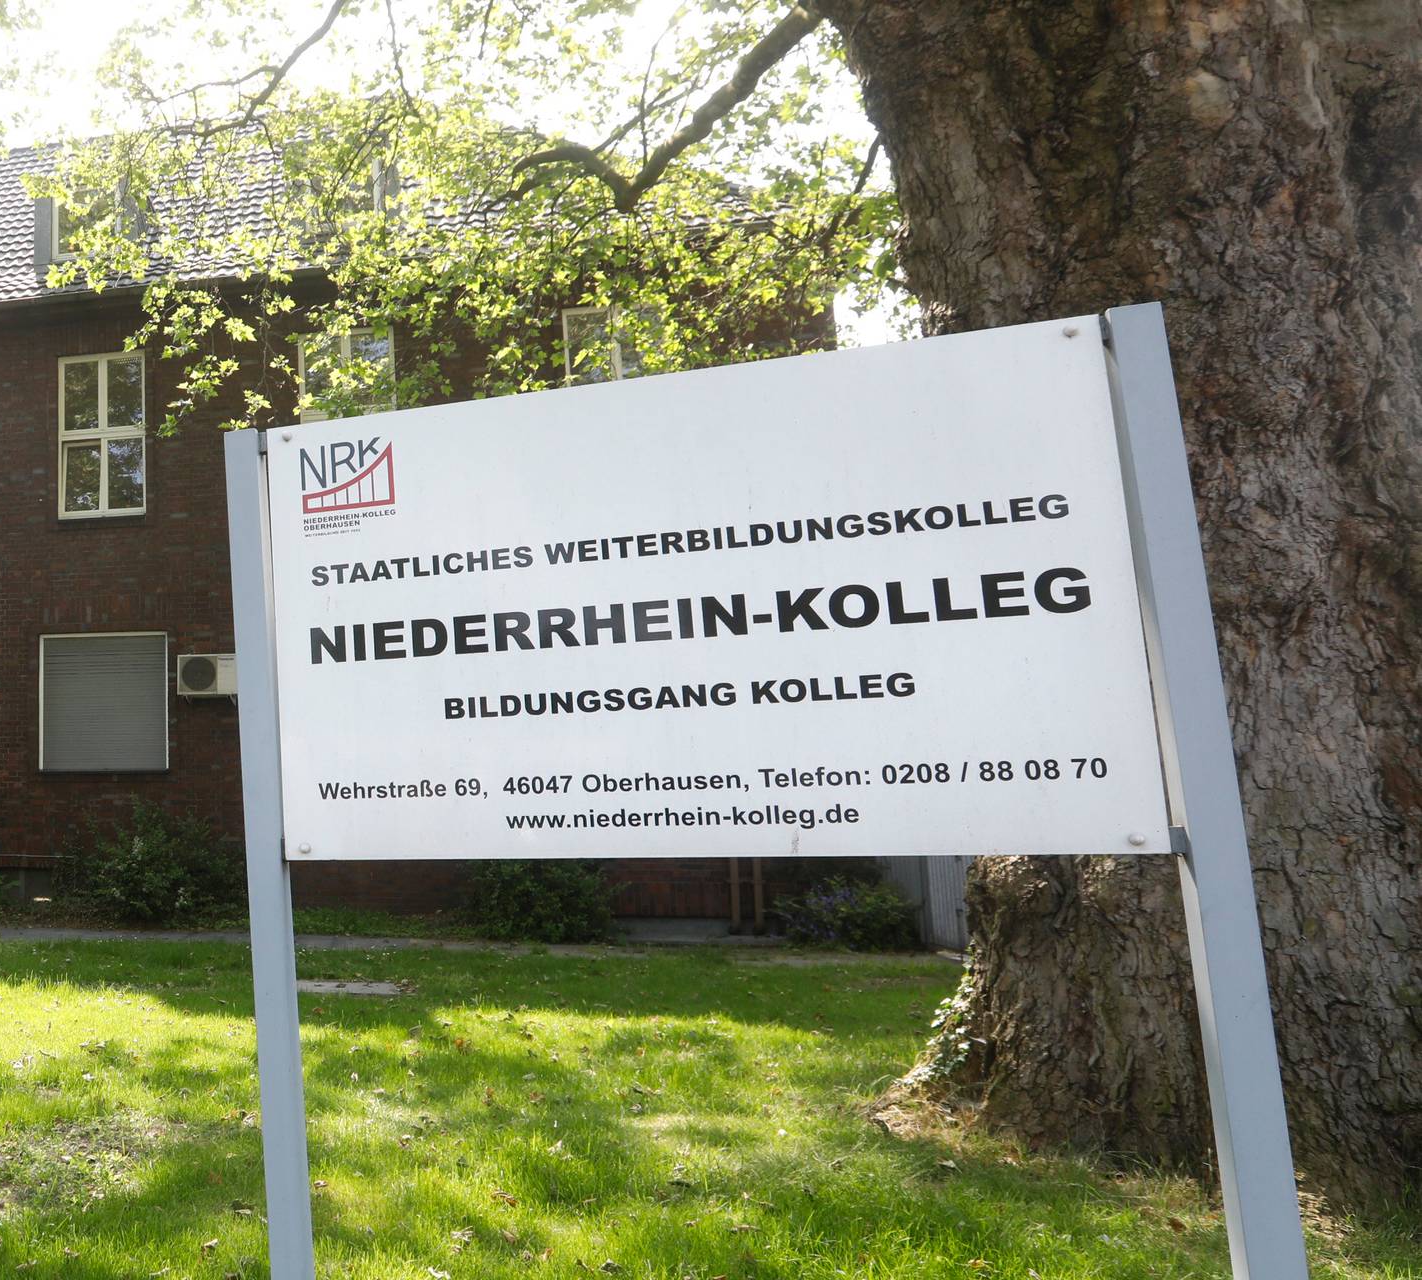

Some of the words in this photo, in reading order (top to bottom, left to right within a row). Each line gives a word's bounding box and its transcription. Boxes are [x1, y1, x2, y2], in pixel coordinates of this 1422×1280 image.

[299, 436, 381, 491] NRK
[303, 509, 396, 525] NIEDERRHEIN-KOLLEG
[303, 520, 361, 532] OBERHAUSEN
[311, 546, 534, 587] STAATLICHES
[544, 494, 1070, 566] WEITERBILDUNGSKOLLEG
[309, 567, 1092, 665] NIEDERRHEIN-KOLLEG
[444, 683, 737, 720] BILDUNGSGANG
[751, 673, 916, 704] KOLLEG
[319, 779, 447, 800] Wehrstraße
[455, 779, 489, 800] 69,
[503, 775, 573, 795] 46047
[582, 773, 750, 793] Oberhausen,
[758, 766, 871, 788] Telefon:
[882, 763, 951, 785] 0208
[961, 762, 969, 783] /
[979, 761, 1014, 782] 88
[1025, 759, 1061, 781] 08
[1071, 758, 1108, 780] 70
[506, 804, 860, 829] www.niederrhein-kolleg.de
